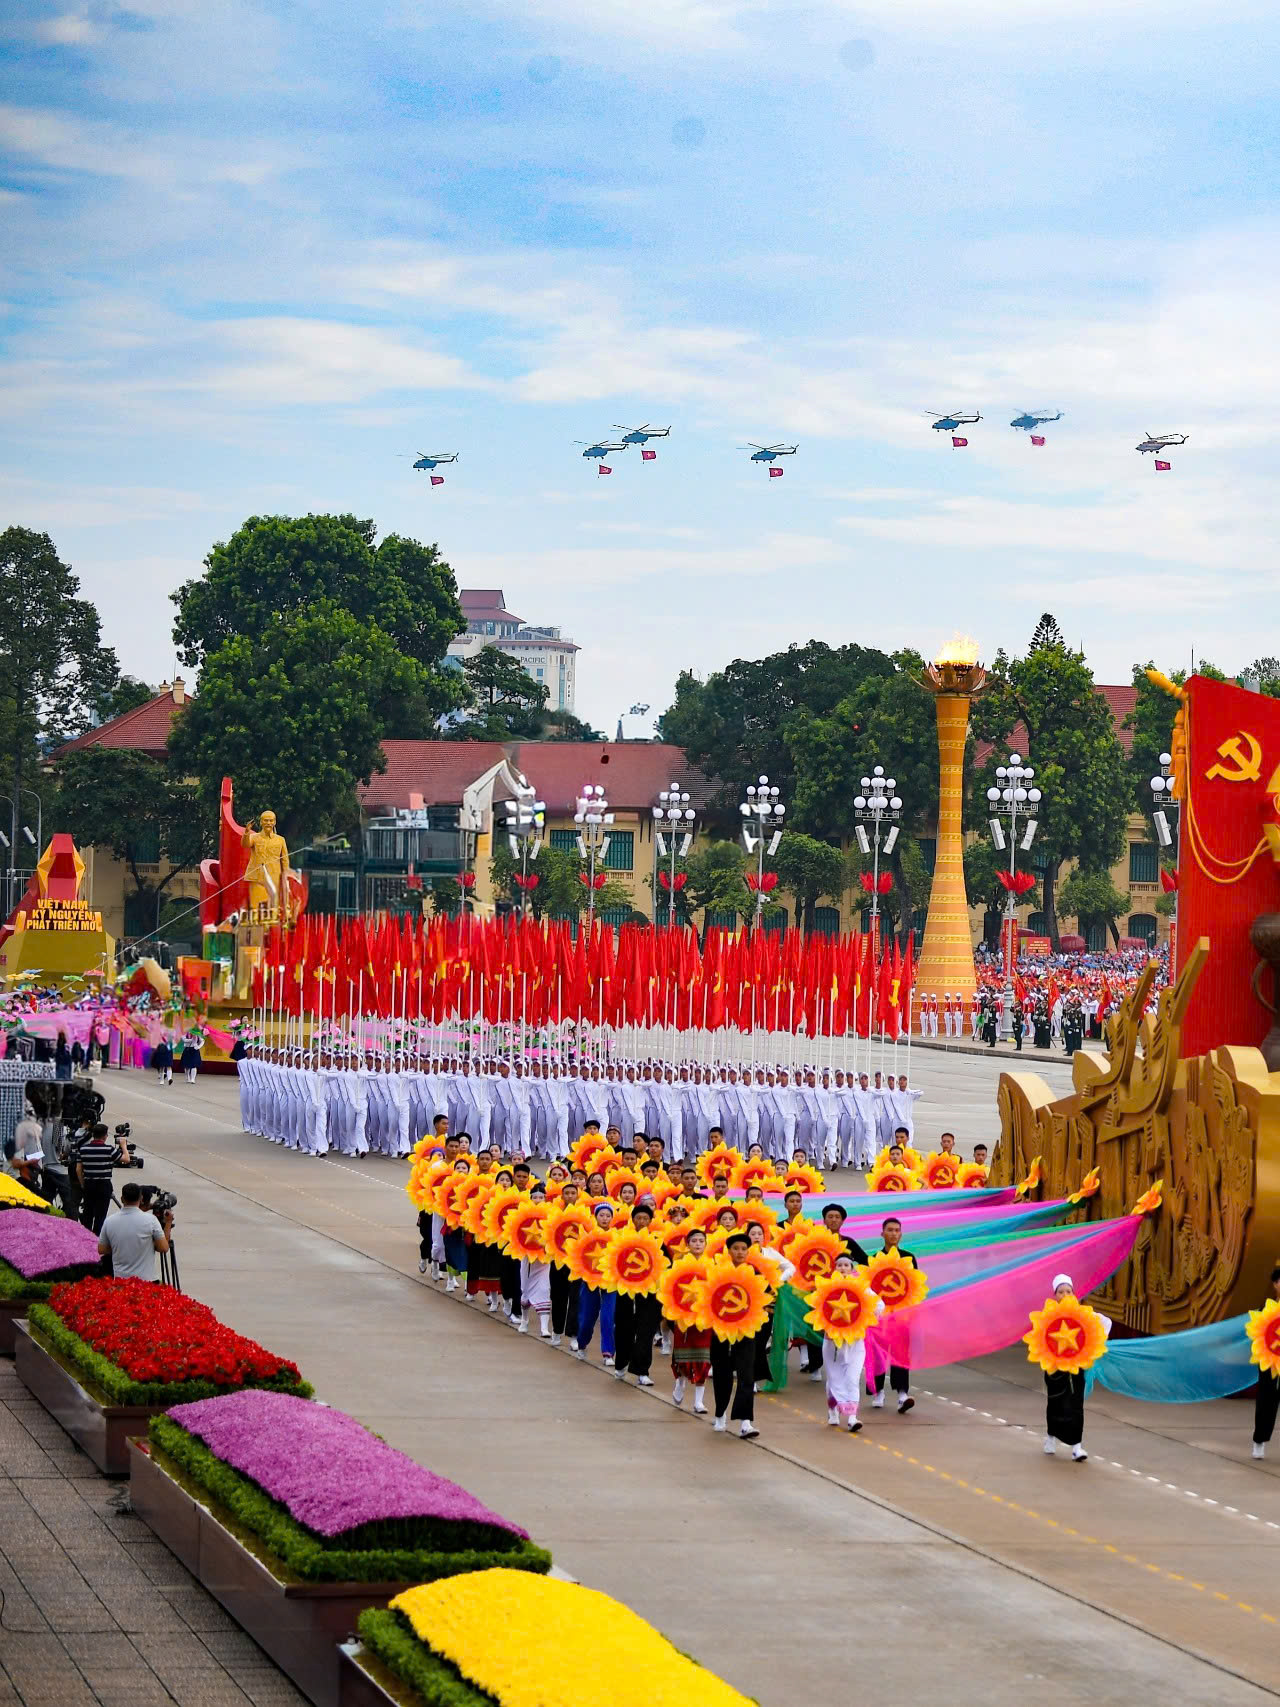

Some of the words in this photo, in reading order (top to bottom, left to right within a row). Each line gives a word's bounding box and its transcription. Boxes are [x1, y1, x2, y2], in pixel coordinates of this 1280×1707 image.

[37, 897, 59, 910] VIỆT
[62, 899, 89, 910] NAM
[48, 908, 93, 921] NGUYÊN
[26, 919, 51, 930] PHÁT
